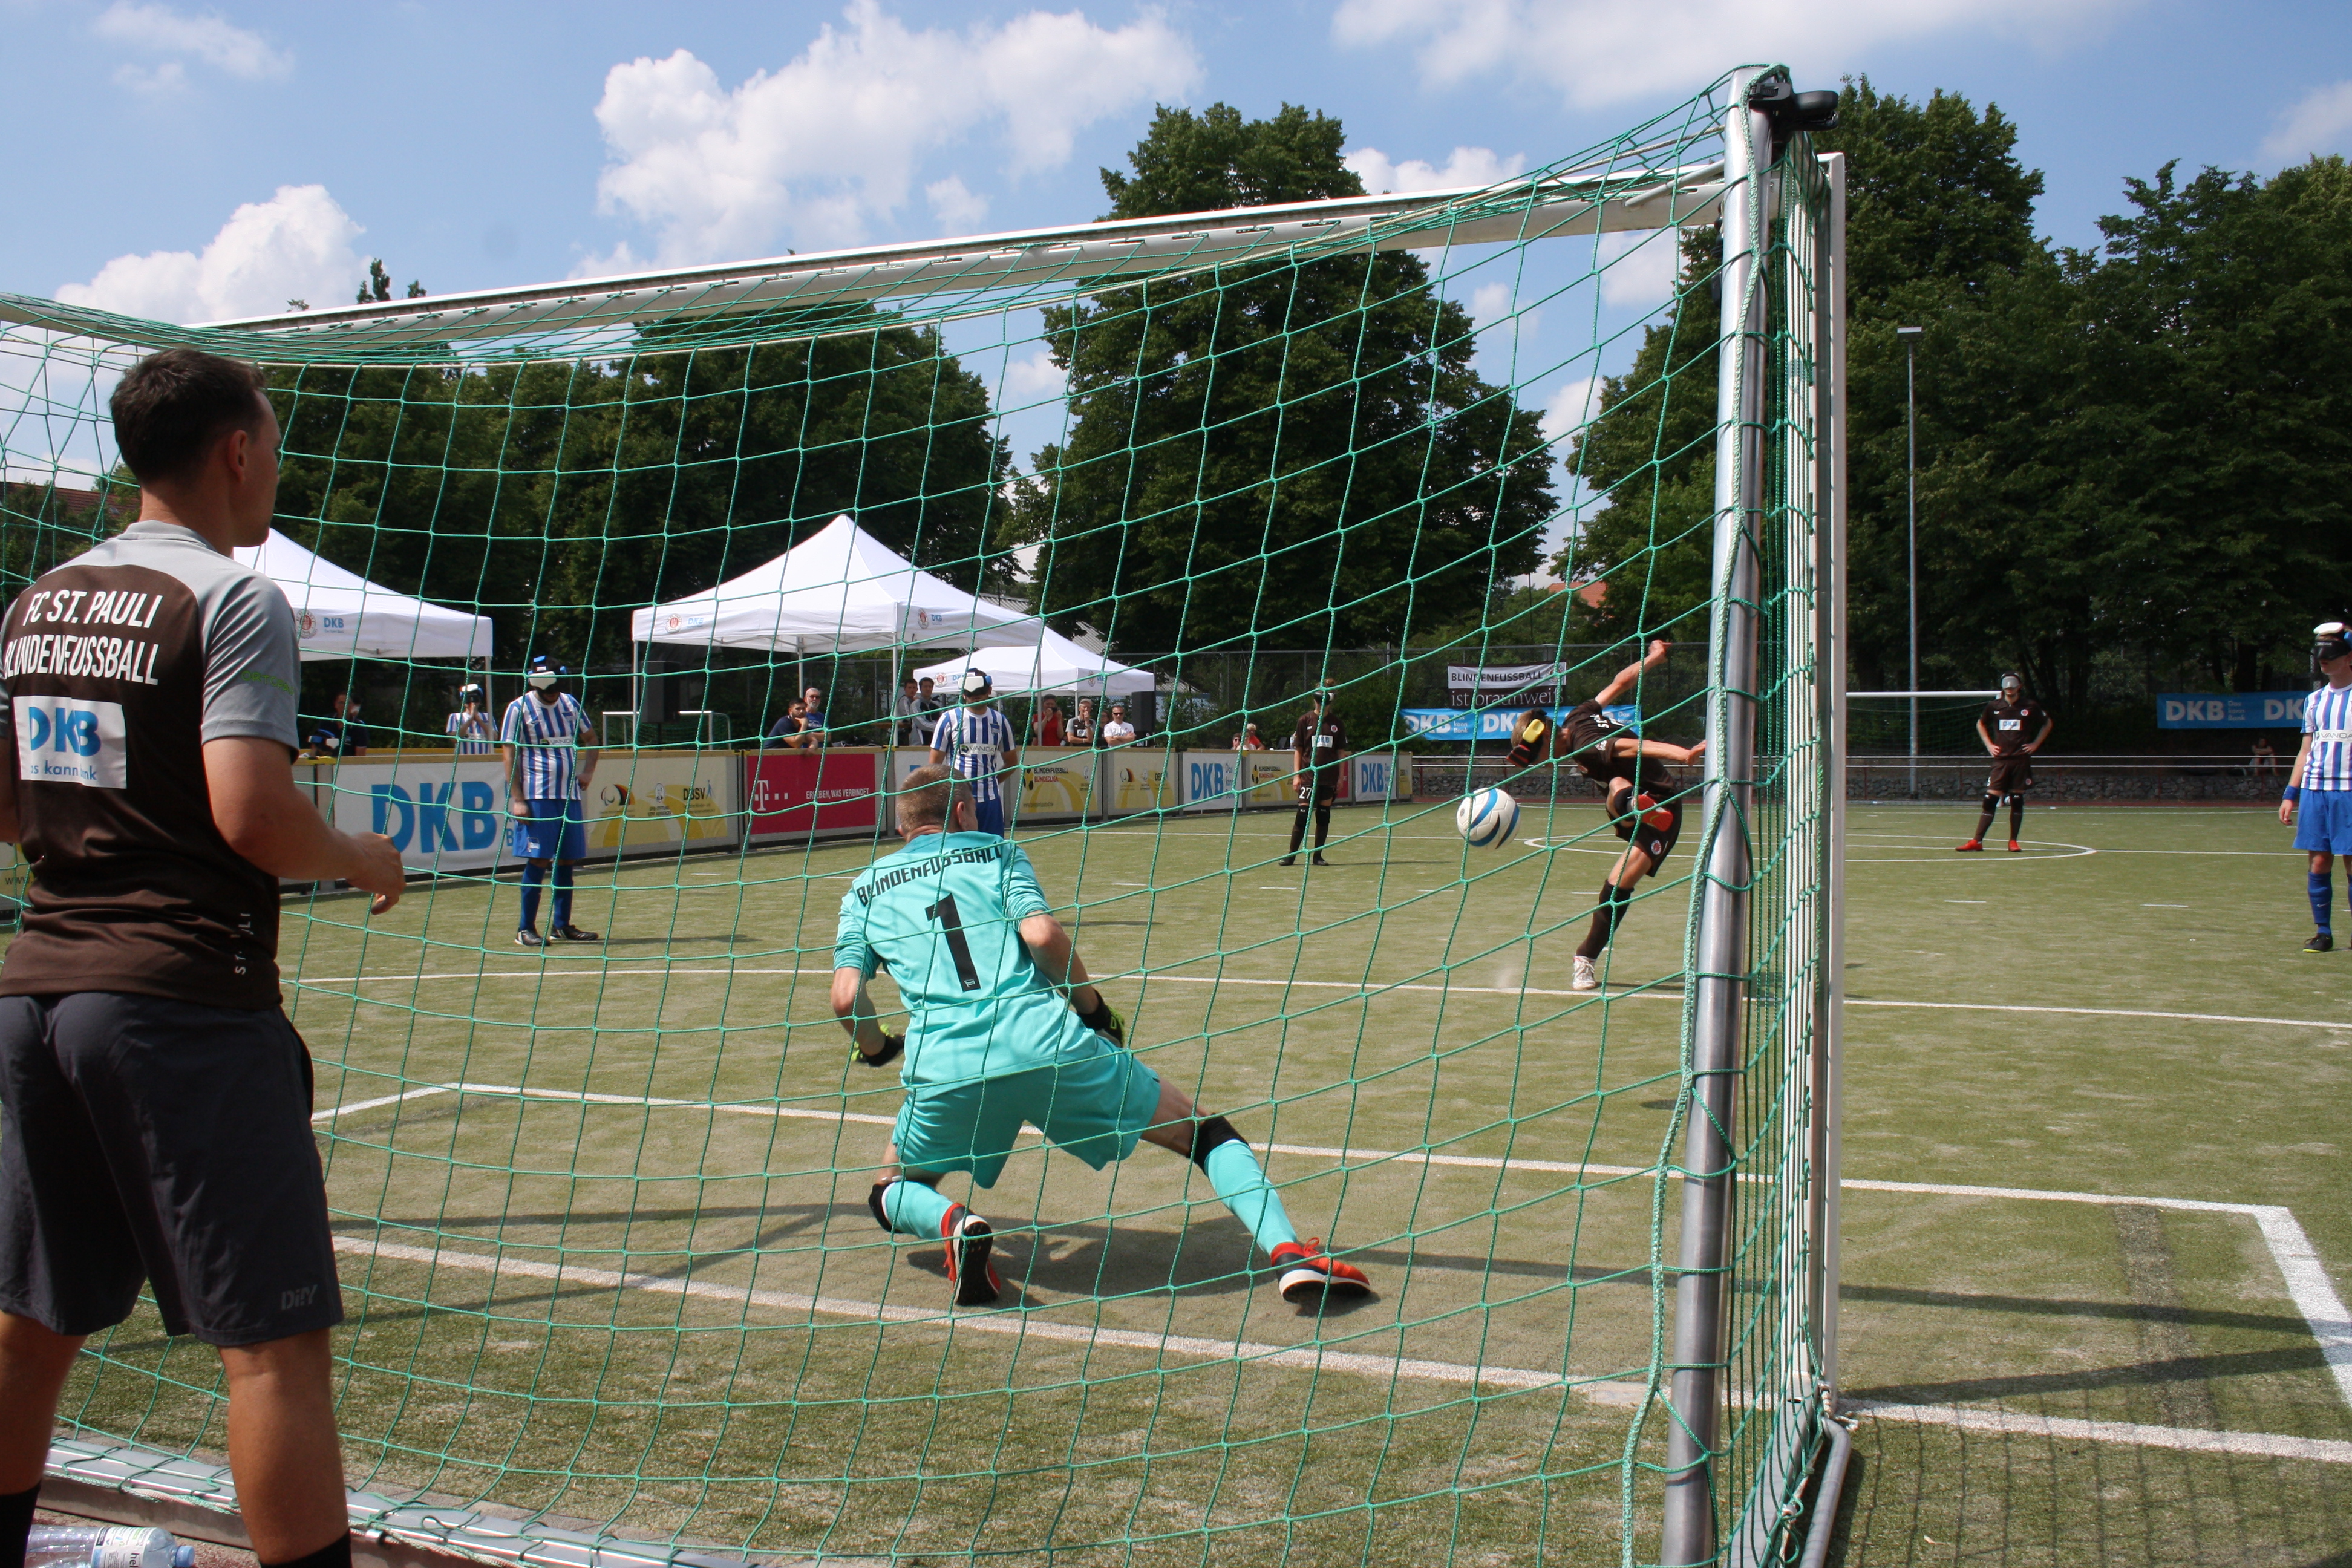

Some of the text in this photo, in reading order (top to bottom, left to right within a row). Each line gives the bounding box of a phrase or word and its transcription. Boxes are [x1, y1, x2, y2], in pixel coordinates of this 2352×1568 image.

[22, 589, 163, 628] FC ST. PAULI
[324, 617, 344, 629] DKB
[4, 635, 159, 685] BLINDENFUSSBALL
[1451, 671, 1543, 682] BLINDENFUSSBALL
[1452, 691, 1469, 707] ist
[2264, 699, 2308, 720] DK
[2166, 700, 2224, 721] DKB
[28, 707, 102, 756] DKB
[1404, 714, 1451, 734] DKB
[1483, 713, 1523, 733] DK
[45, 760, 79, 776] kann
[1361, 763, 1384, 793] DKB
[1191, 763, 1224, 800] DKB
[683, 787, 706, 800] DBSV
[842, 788, 870, 797] VERBINDET
[1299, 786, 1312, 799] 27
[371, 781, 497, 854] DKB
[856, 841, 1002, 907] BLINDENFUSSBALL
[925, 892, 982, 993] 1
